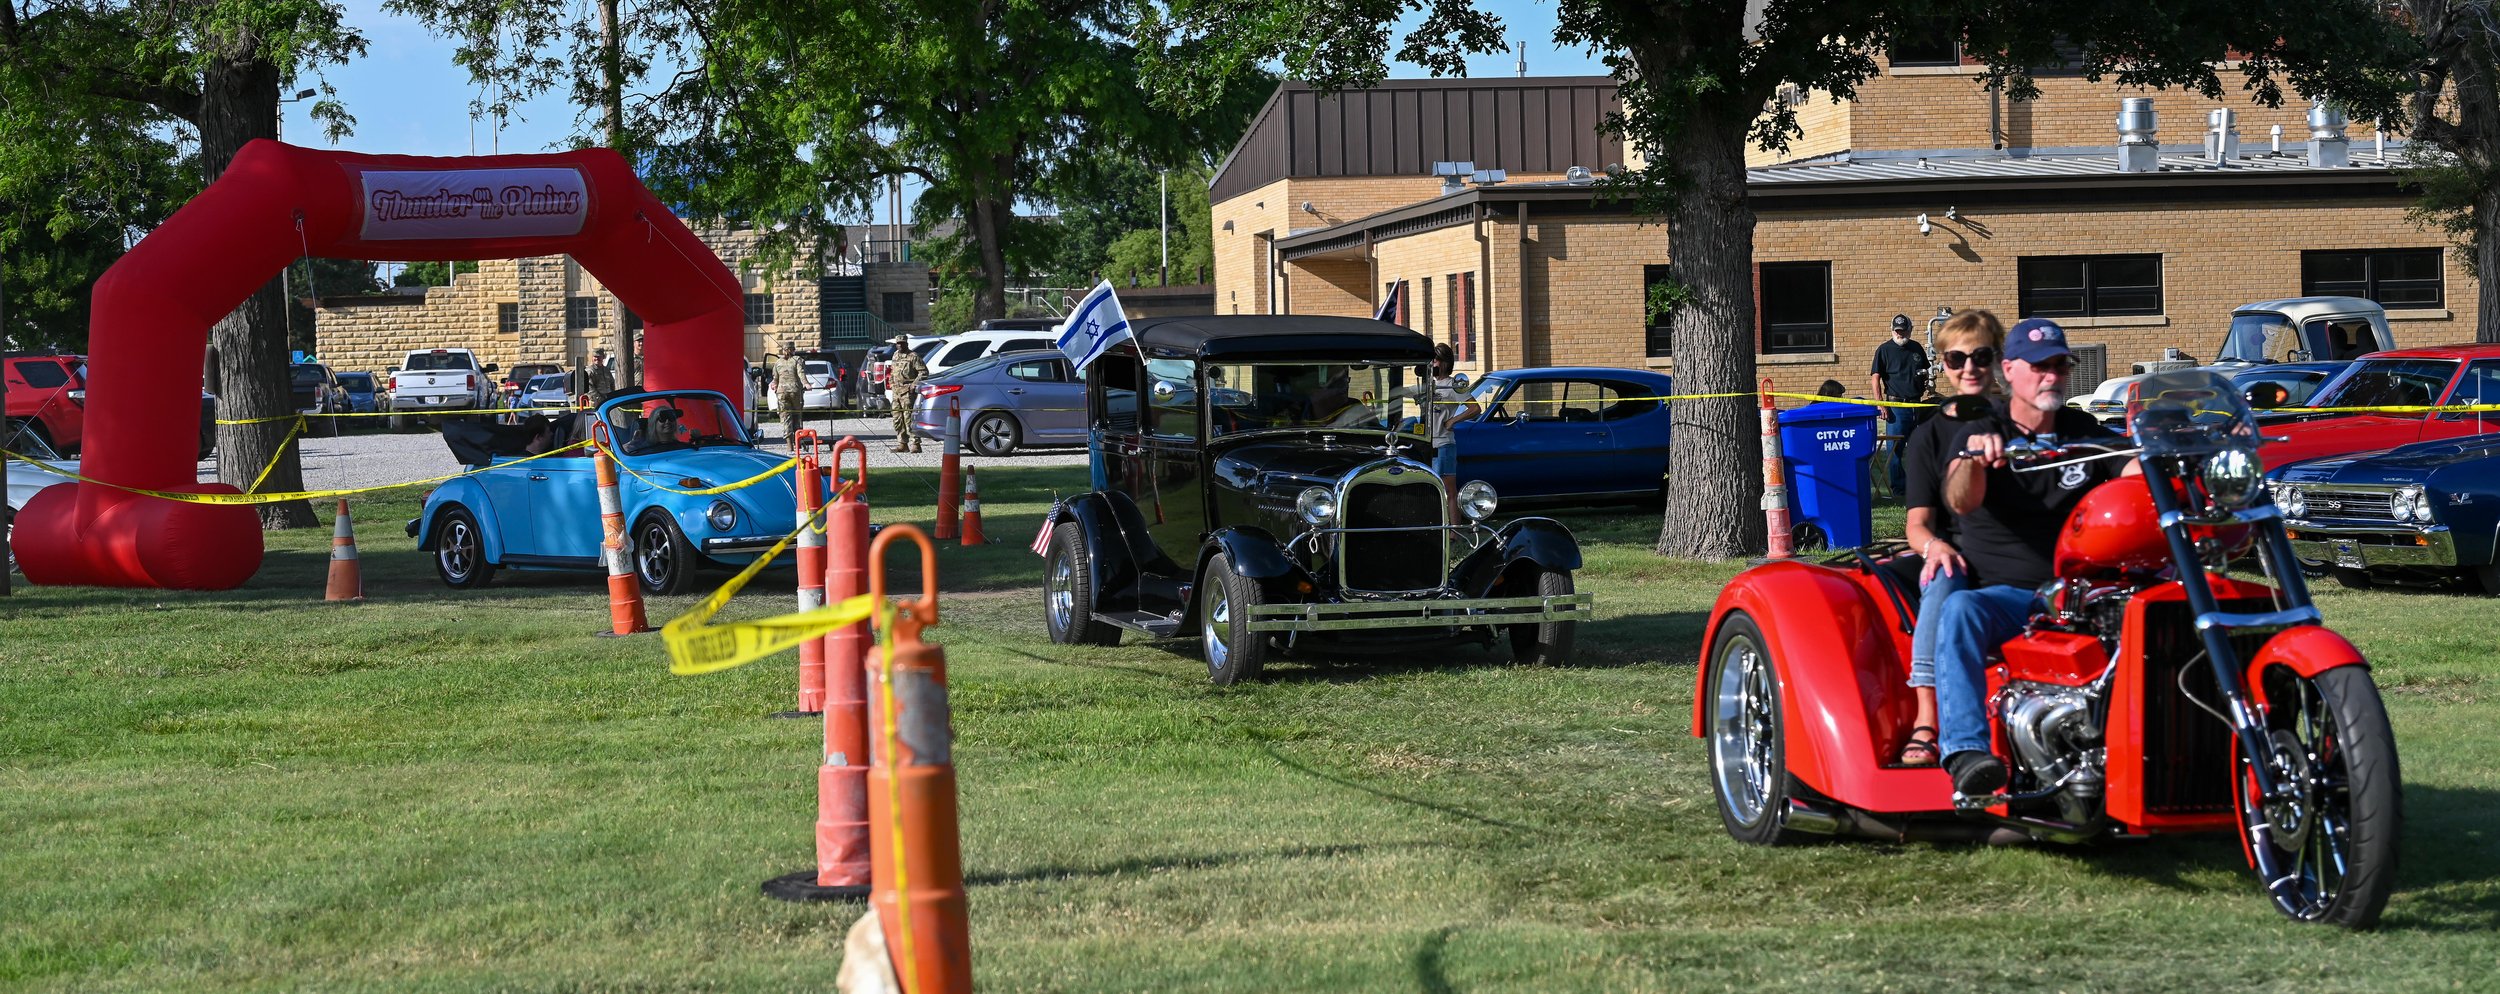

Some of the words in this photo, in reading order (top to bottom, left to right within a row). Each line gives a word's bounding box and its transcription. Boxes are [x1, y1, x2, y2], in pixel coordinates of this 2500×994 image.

[473, 187, 493, 203] on
[500, 184, 579, 216] Plains
[372, 188, 473, 221] Thunder
[480, 200, 504, 220] the
[1816, 430, 1840, 440] CITY
[1842, 429, 1856, 438] OF
[1824, 441, 1851, 451] HAYS
[2327, 500, 2341, 508] SS
